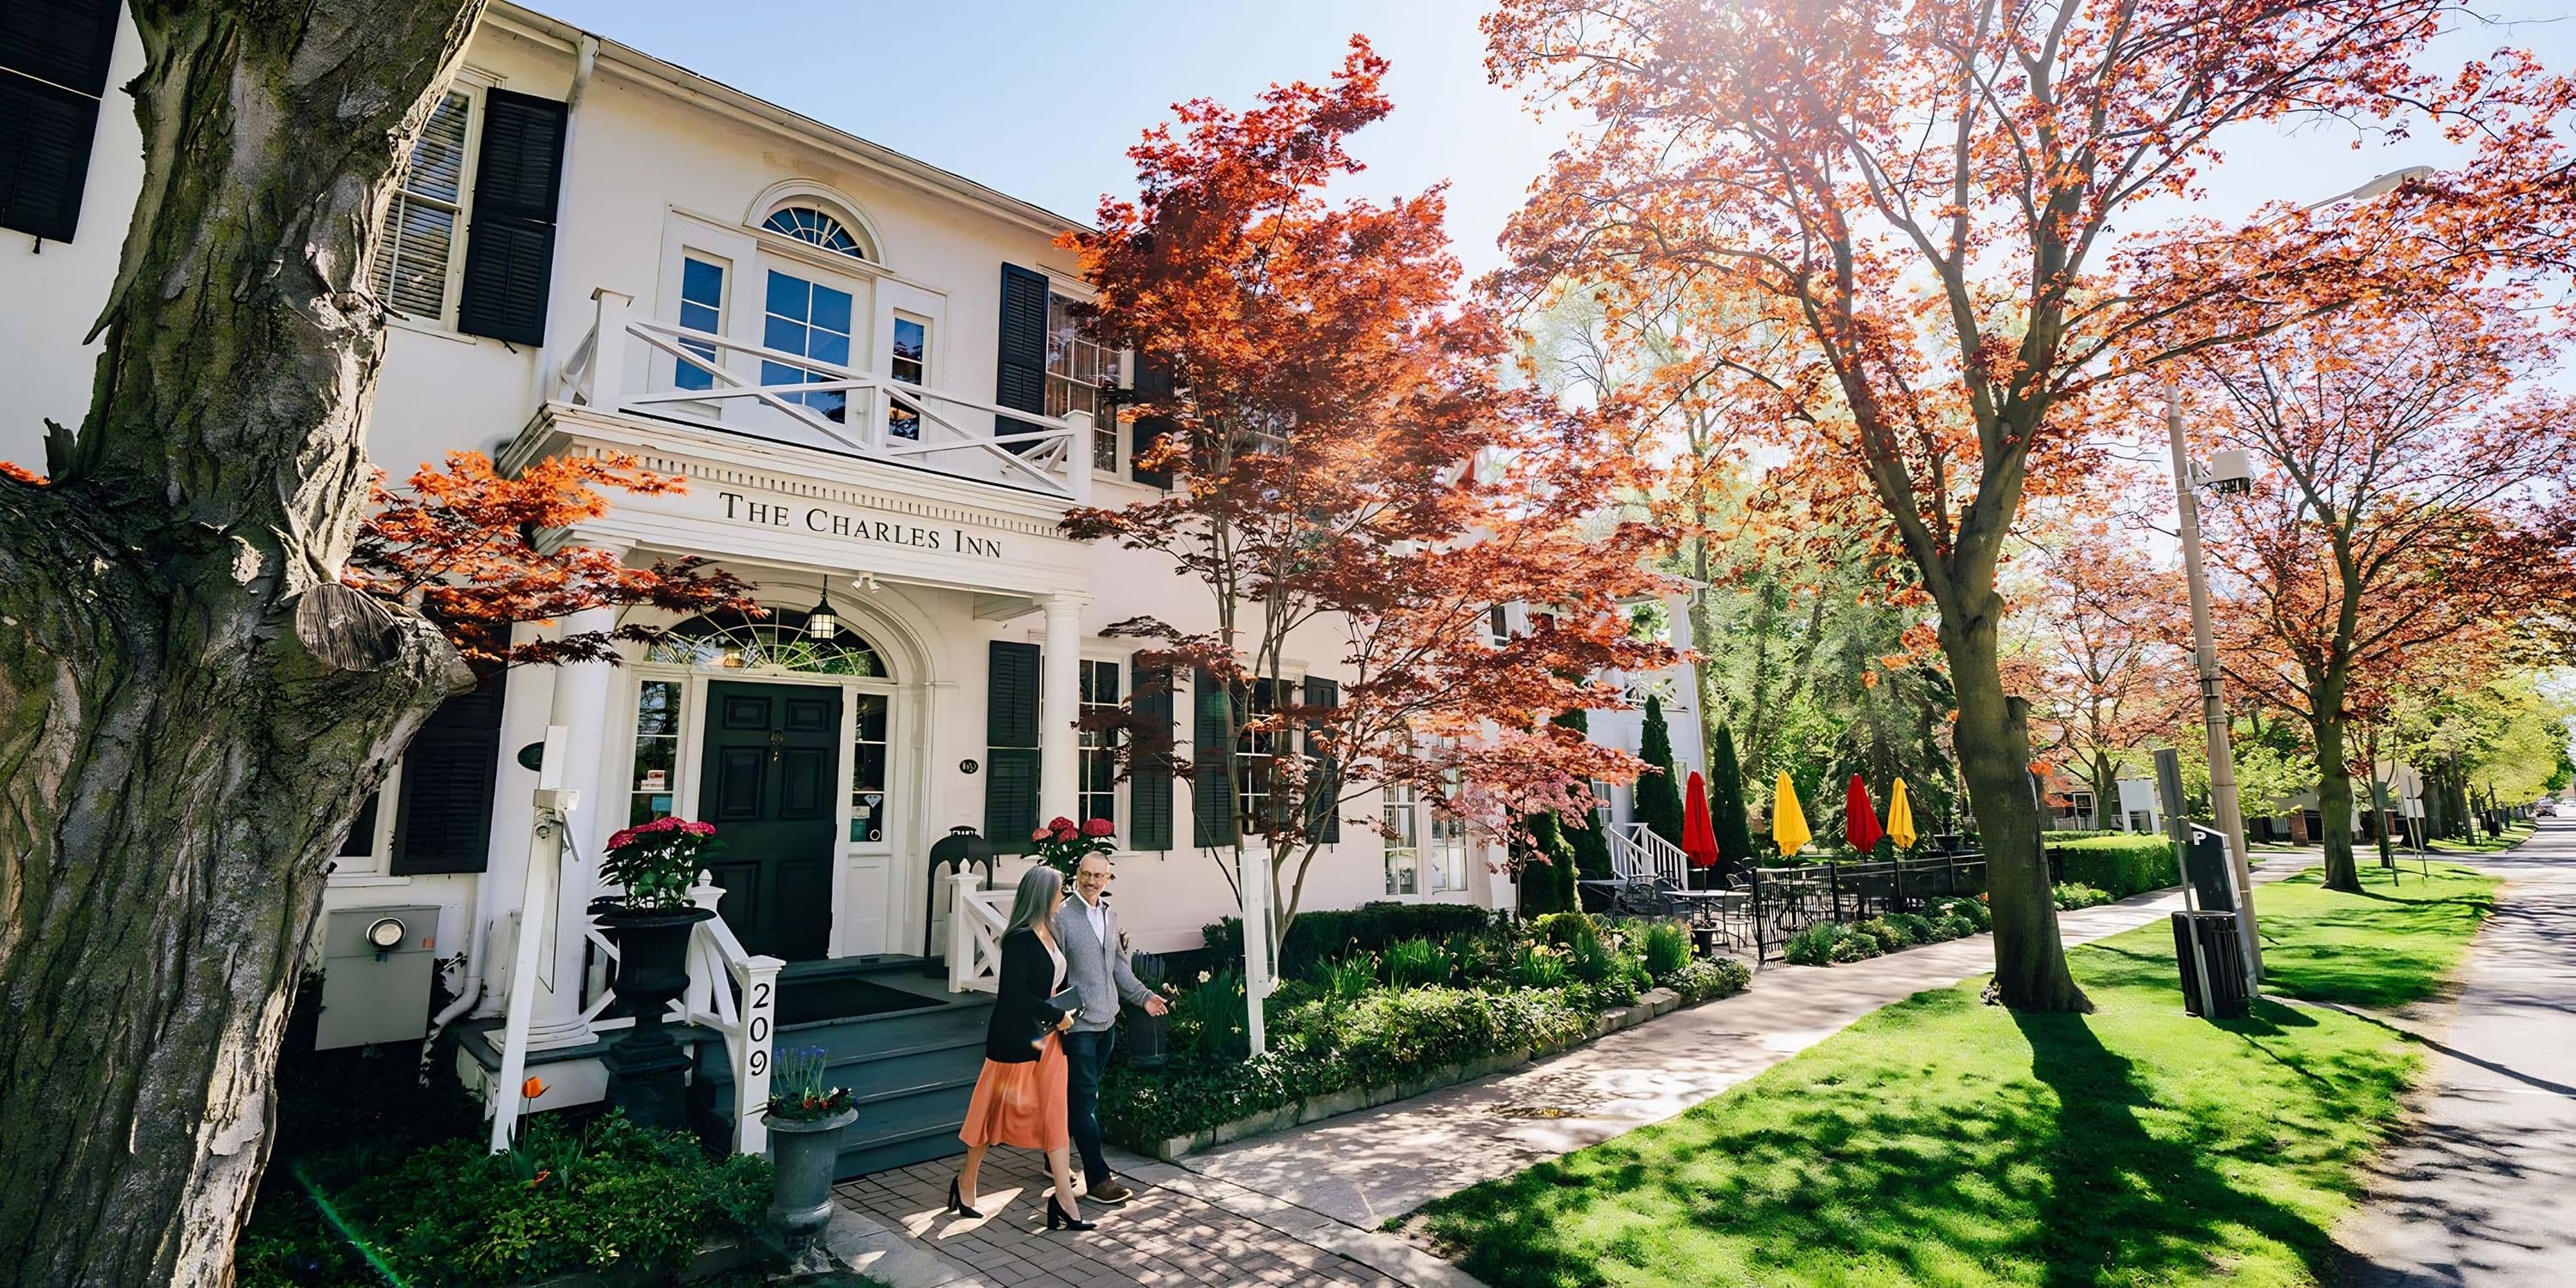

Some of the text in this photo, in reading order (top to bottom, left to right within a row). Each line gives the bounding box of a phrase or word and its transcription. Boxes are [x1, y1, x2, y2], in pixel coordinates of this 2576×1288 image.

[719, 492, 1001, 558] THE CHARLES INN
[2192, 830, 2207, 846] P
[750, 982, 770, 1077] 209
